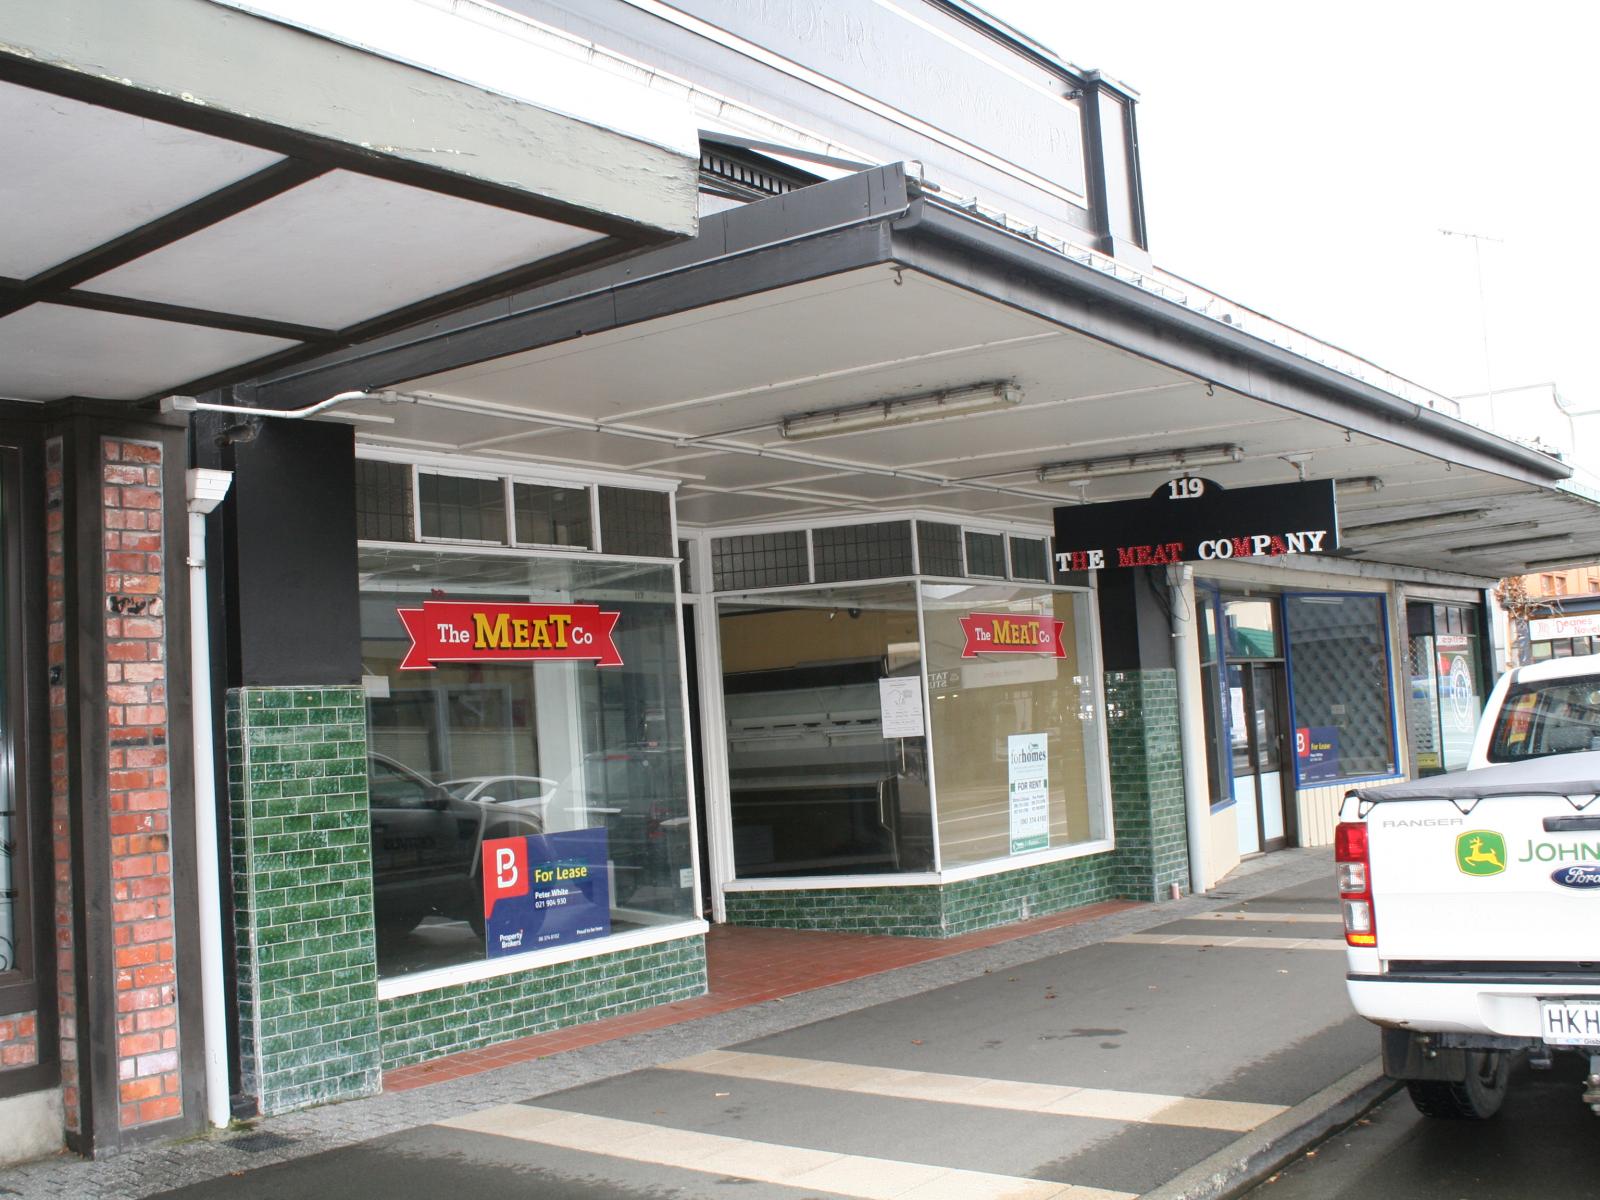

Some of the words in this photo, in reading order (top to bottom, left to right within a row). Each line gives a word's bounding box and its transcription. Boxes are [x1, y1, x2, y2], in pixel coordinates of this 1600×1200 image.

[1168, 478, 1205, 500] 119
[1056, 549, 1105, 572] THE
[1116, 542, 1184, 567] MEAT
[1198, 530, 1327, 560] COMPANY
[437, 623, 470, 644] The
[473, 612, 572, 650] MEAT
[571, 626, 593, 645] Co
[974, 627, 991, 641] The
[992, 619, 1040, 645] MEAT
[1039, 630, 1050, 643] Co
[1382, 818, 1464, 829] RANGER
[1518, 839, 1600, 863] JOHN
[535, 869, 553, 883] For
[557, 866, 587, 880] Lease
[534, 890, 550, 900] Peter
[551, 888, 569, 898] White
[534, 900, 545, 909] 021
[546, 899, 556, 908] 904
[557, 897, 567, 906] 930
[499, 931, 522, 943] Property
[501, 939, 522, 949] Brokers
[1548, 1009, 1600, 1034] HKH
